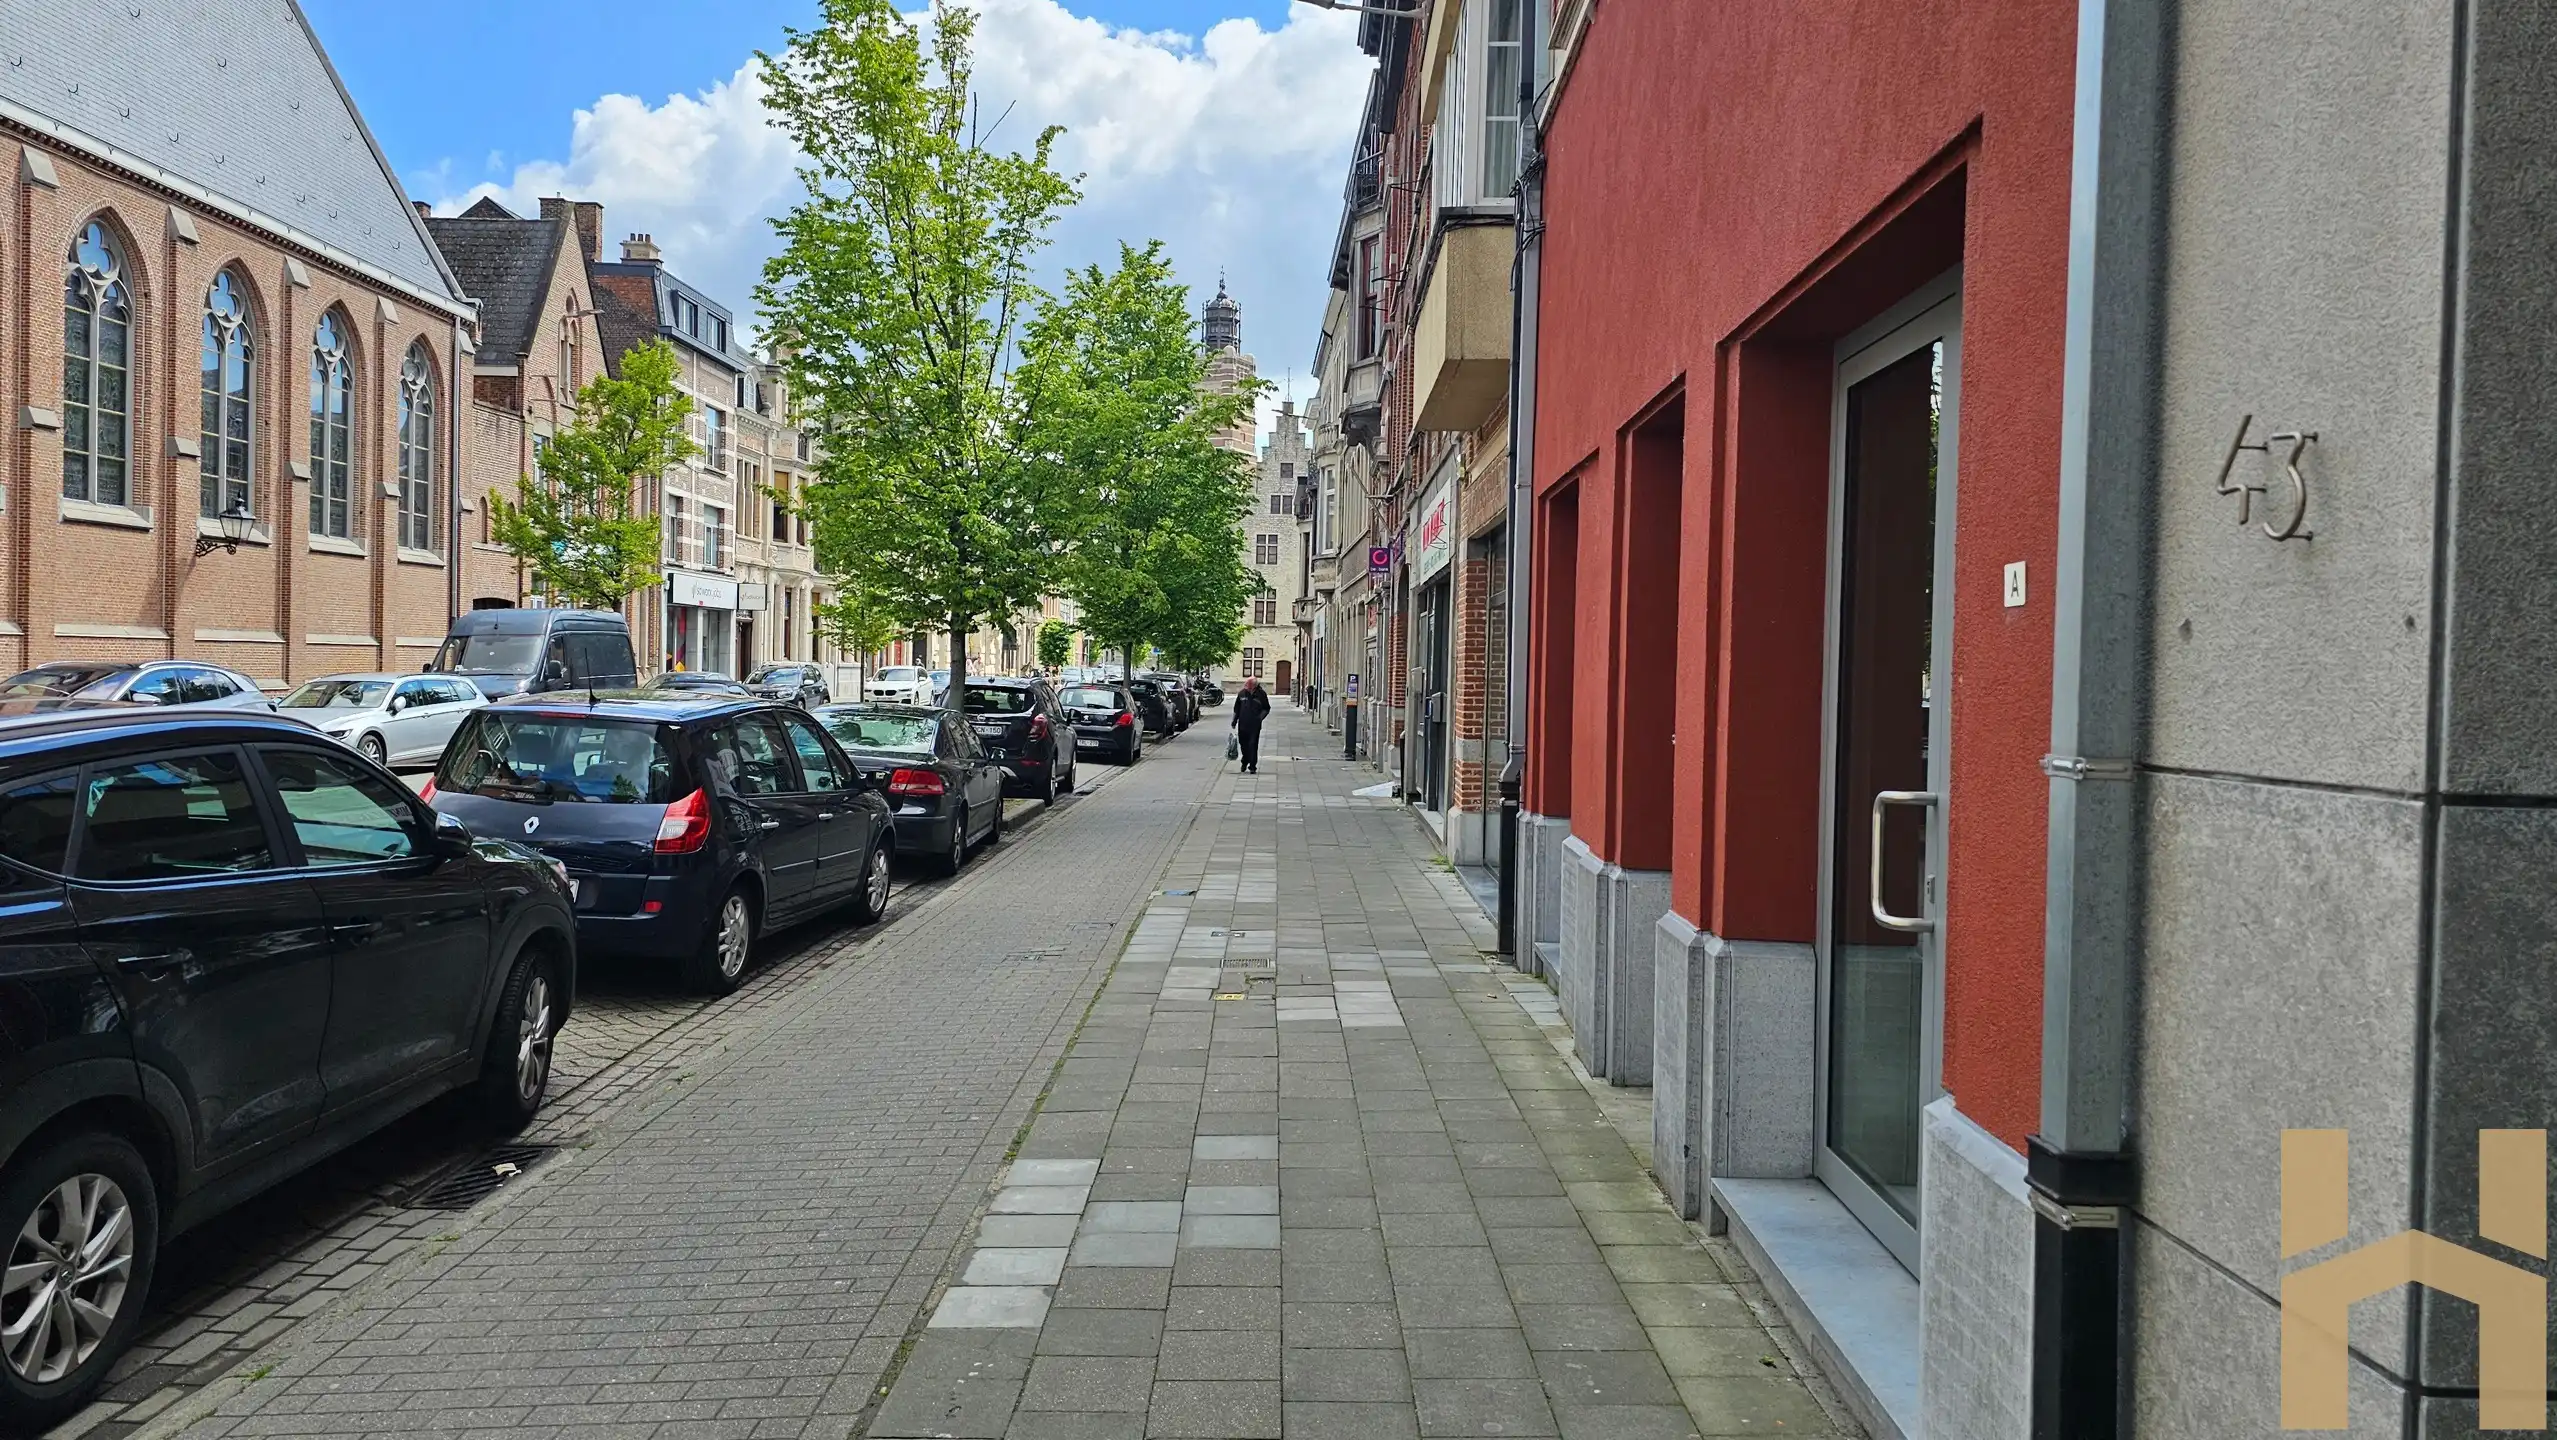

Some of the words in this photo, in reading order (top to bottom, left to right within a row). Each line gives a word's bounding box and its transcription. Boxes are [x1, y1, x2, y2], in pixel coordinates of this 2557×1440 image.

[2217, 414, 2307, 541] 43
[2011, 570, 2019, 598] A
[975, 726, 1002, 734] CN-150
